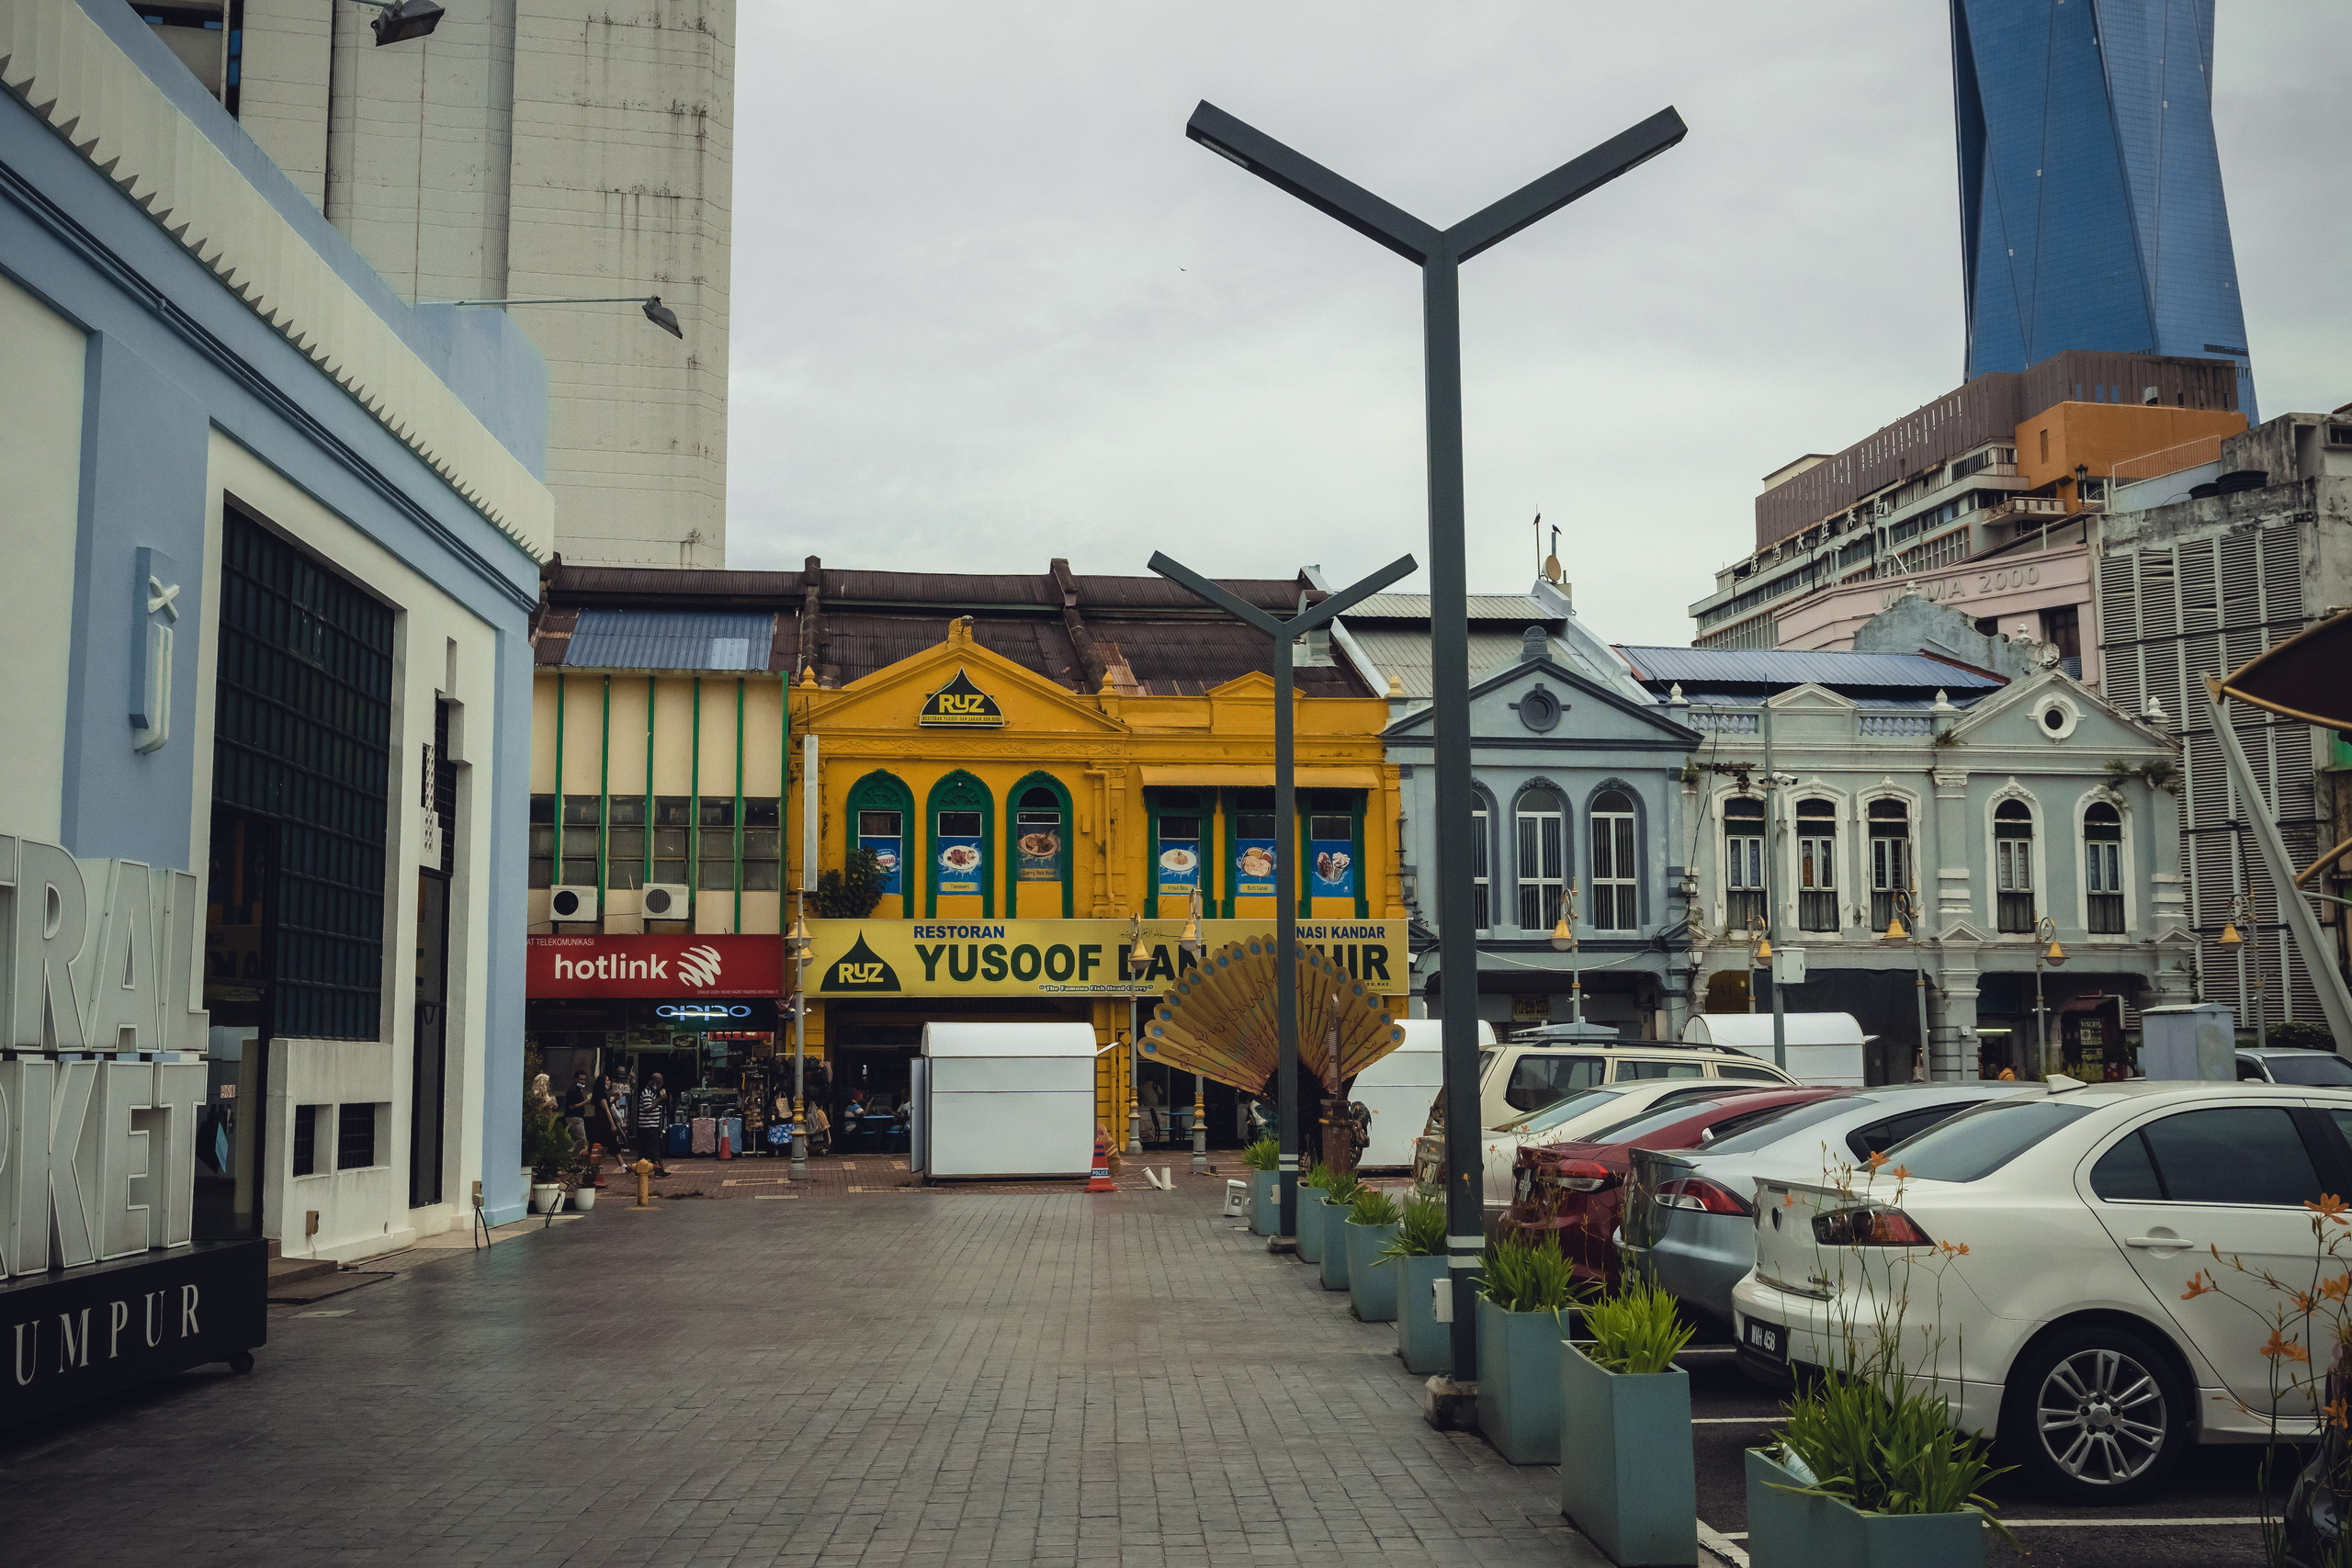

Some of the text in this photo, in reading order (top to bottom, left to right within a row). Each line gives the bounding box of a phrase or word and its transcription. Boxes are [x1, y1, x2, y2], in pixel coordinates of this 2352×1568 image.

[1978, 566, 2040, 593] 2000
[537, 938, 594, 946] TELEKOMUNIKASI
[913, 925, 1005, 939] RESTORAN
[1296, 926, 1385, 939] NASI KANDAR
[555, 953, 669, 980] hotlink
[914, 943, 1102, 982] YUSOOF
[0, 1060, 209, 1280] KET
[1764, 1330, 1776, 1352] 458
